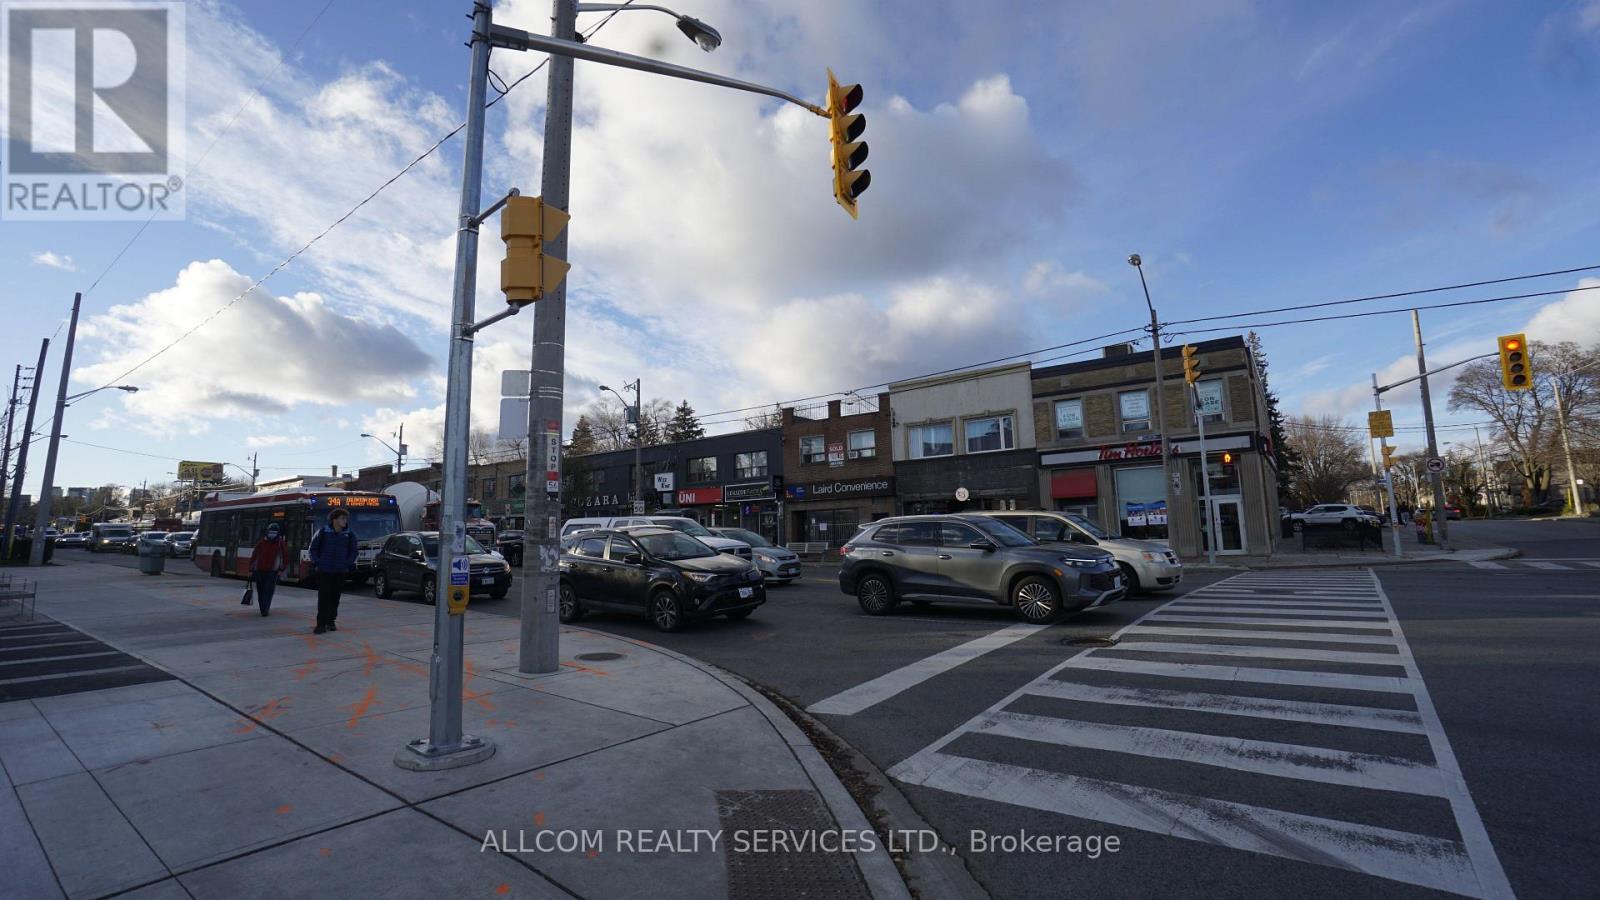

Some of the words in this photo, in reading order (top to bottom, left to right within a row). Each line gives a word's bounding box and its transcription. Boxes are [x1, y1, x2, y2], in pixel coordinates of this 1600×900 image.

[1122, 441, 1180, 459] Hortos
[812, 483, 832, 494] Laird
[834, 480, 888, 493] Convenience
